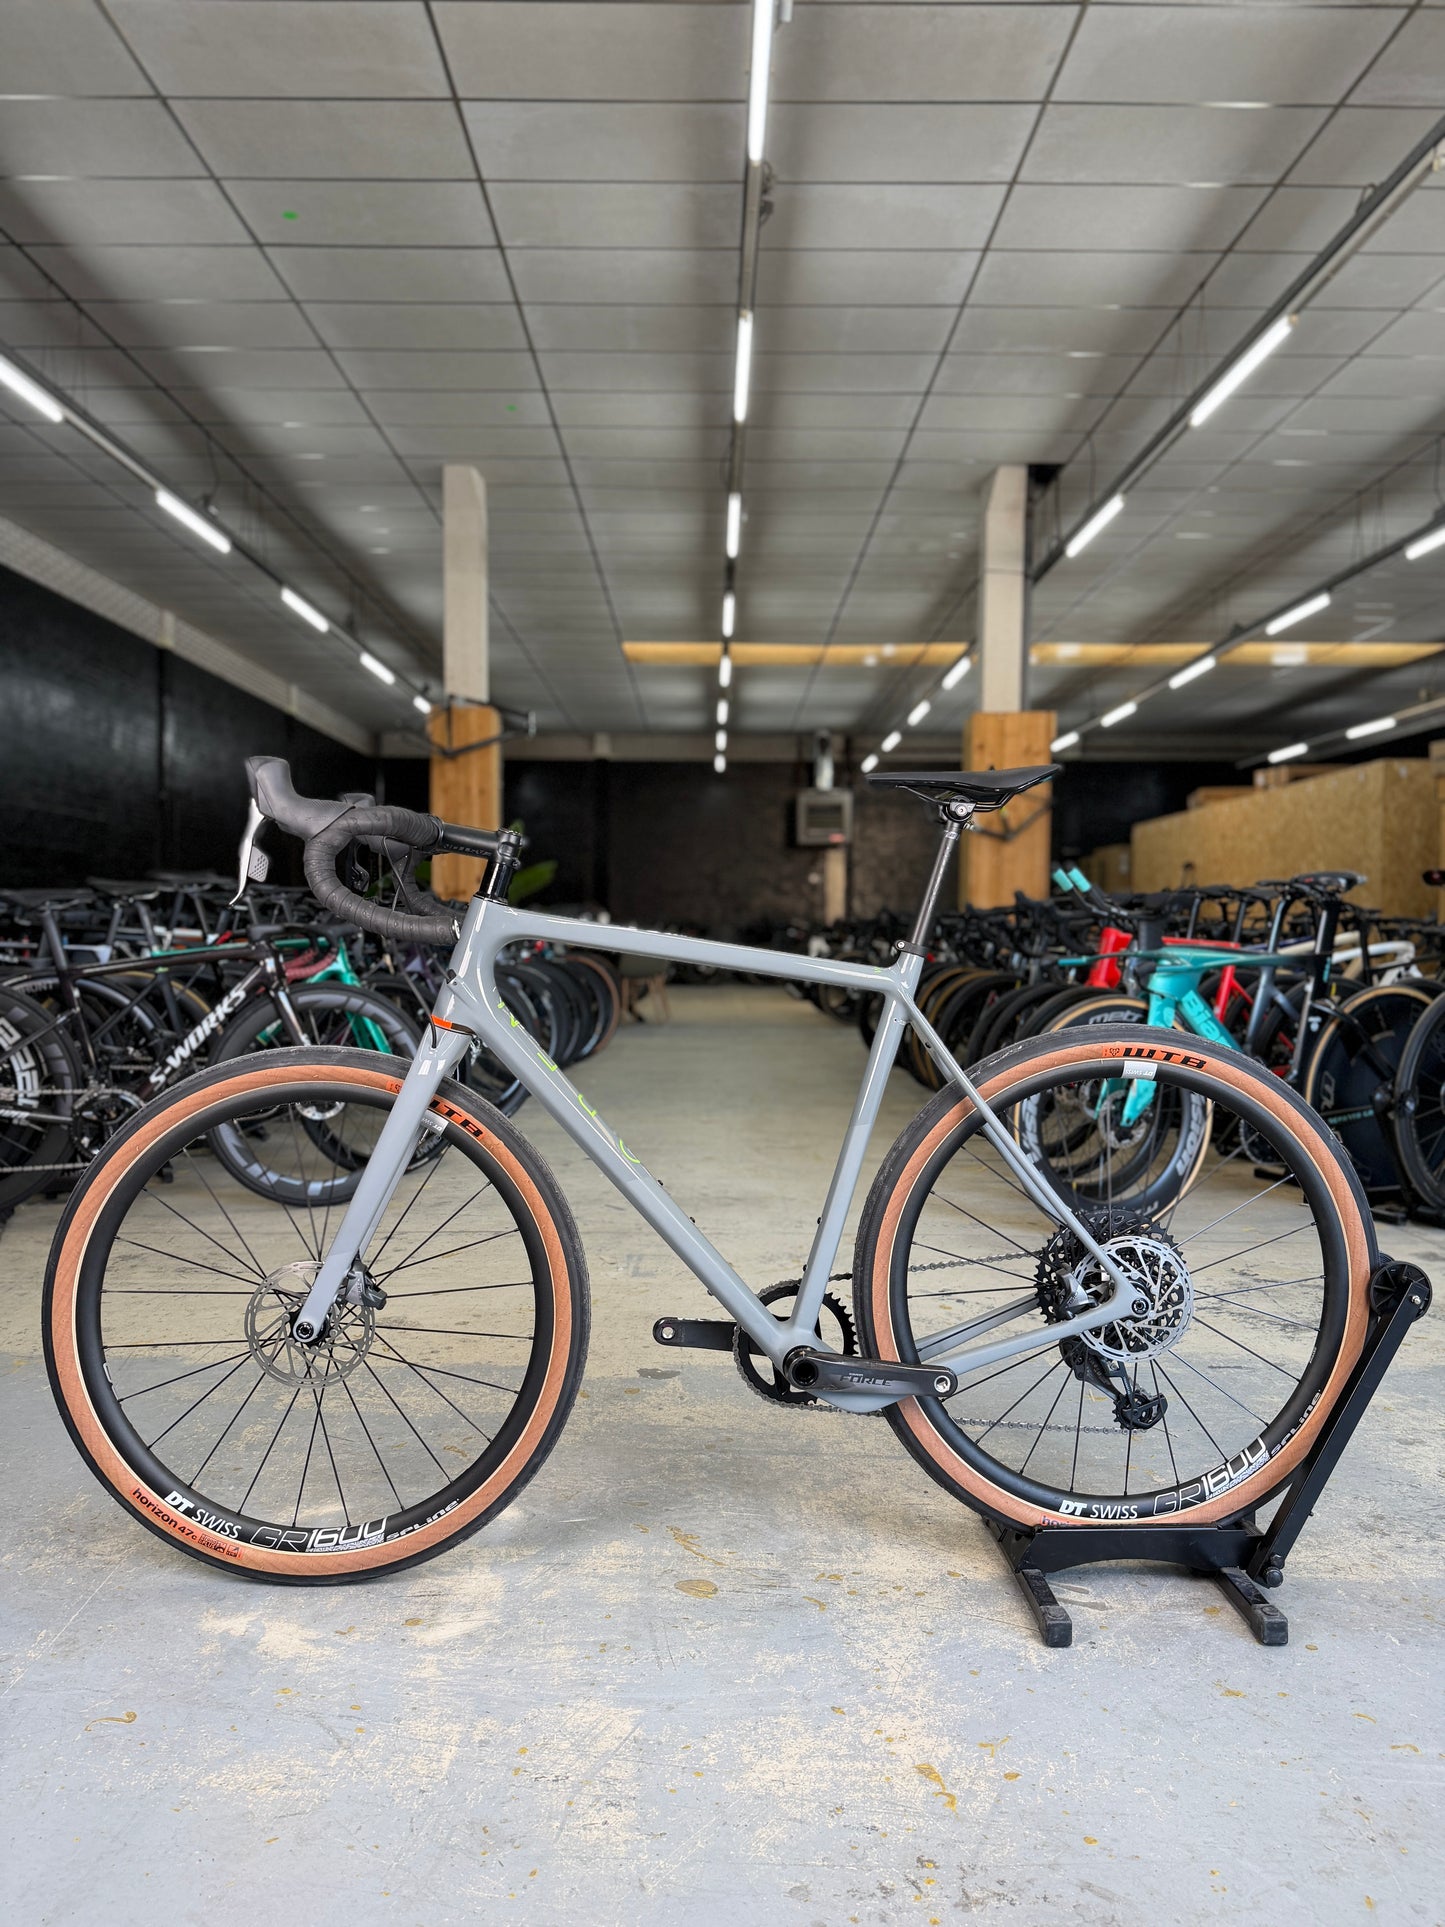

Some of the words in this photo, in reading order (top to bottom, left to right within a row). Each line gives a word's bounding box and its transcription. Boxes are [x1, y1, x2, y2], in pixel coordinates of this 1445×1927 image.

[149, 988, 247, 1091] S-WORKS
[1122, 1047, 1207, 1069] WTB
[840, 1375, 892, 1387] FORCE
[132, 1487, 178, 1529] horizon
[178, 1525, 198, 1541] 47c
[163, 1490, 195, 1513] DT
[191, 1508, 242, 1539] SWISS
[1059, 1499, 1088, 1516] DT
[1090, 1504, 1138, 1520] SWISS
